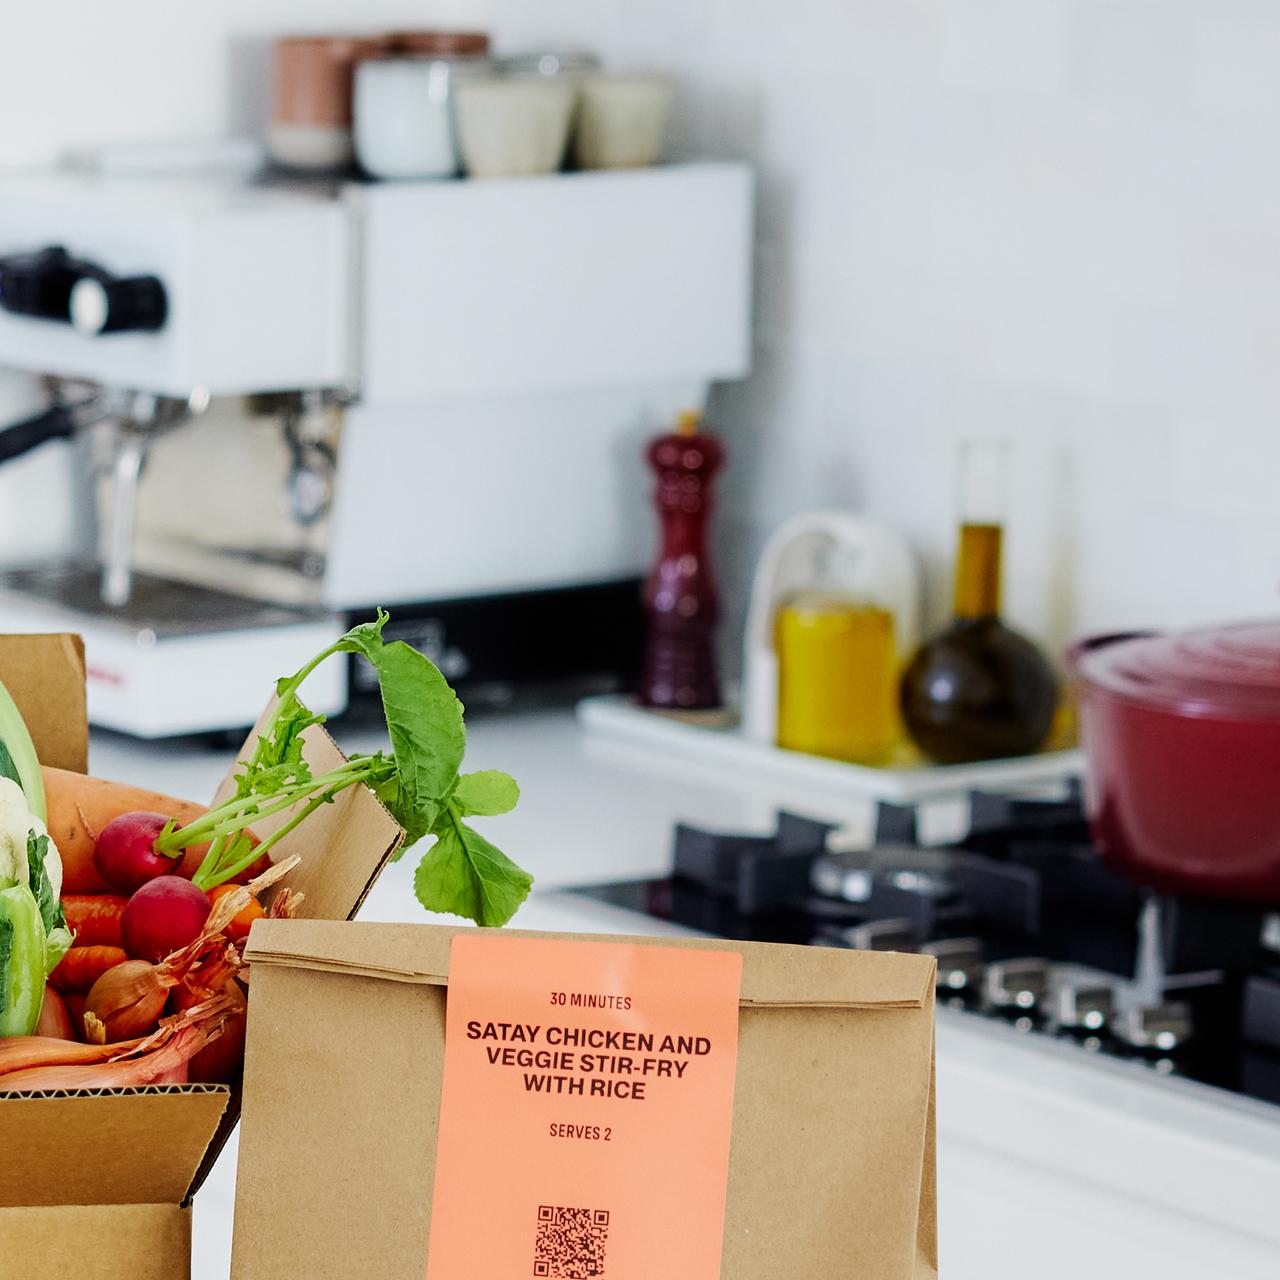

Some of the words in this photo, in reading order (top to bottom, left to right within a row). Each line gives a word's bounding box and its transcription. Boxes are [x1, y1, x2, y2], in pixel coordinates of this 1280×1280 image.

[550, 992, 566, 1006] 30
[570, 994, 632, 1010] MINUTES
[466, 1021, 540, 1043] SATAY
[546, 1027, 653, 1052] CHICKEN
[659, 1035, 711, 1056] AND
[486, 1047, 575, 1071] VEGGIE
[580, 1054, 689, 1078] STIR-FRY
[523, 1074, 584, 1096] WITH
[590, 1079, 646, 1100] RICE
[549, 1123, 600, 1140] SERVES
[604, 1128, 612, 1141] 2
